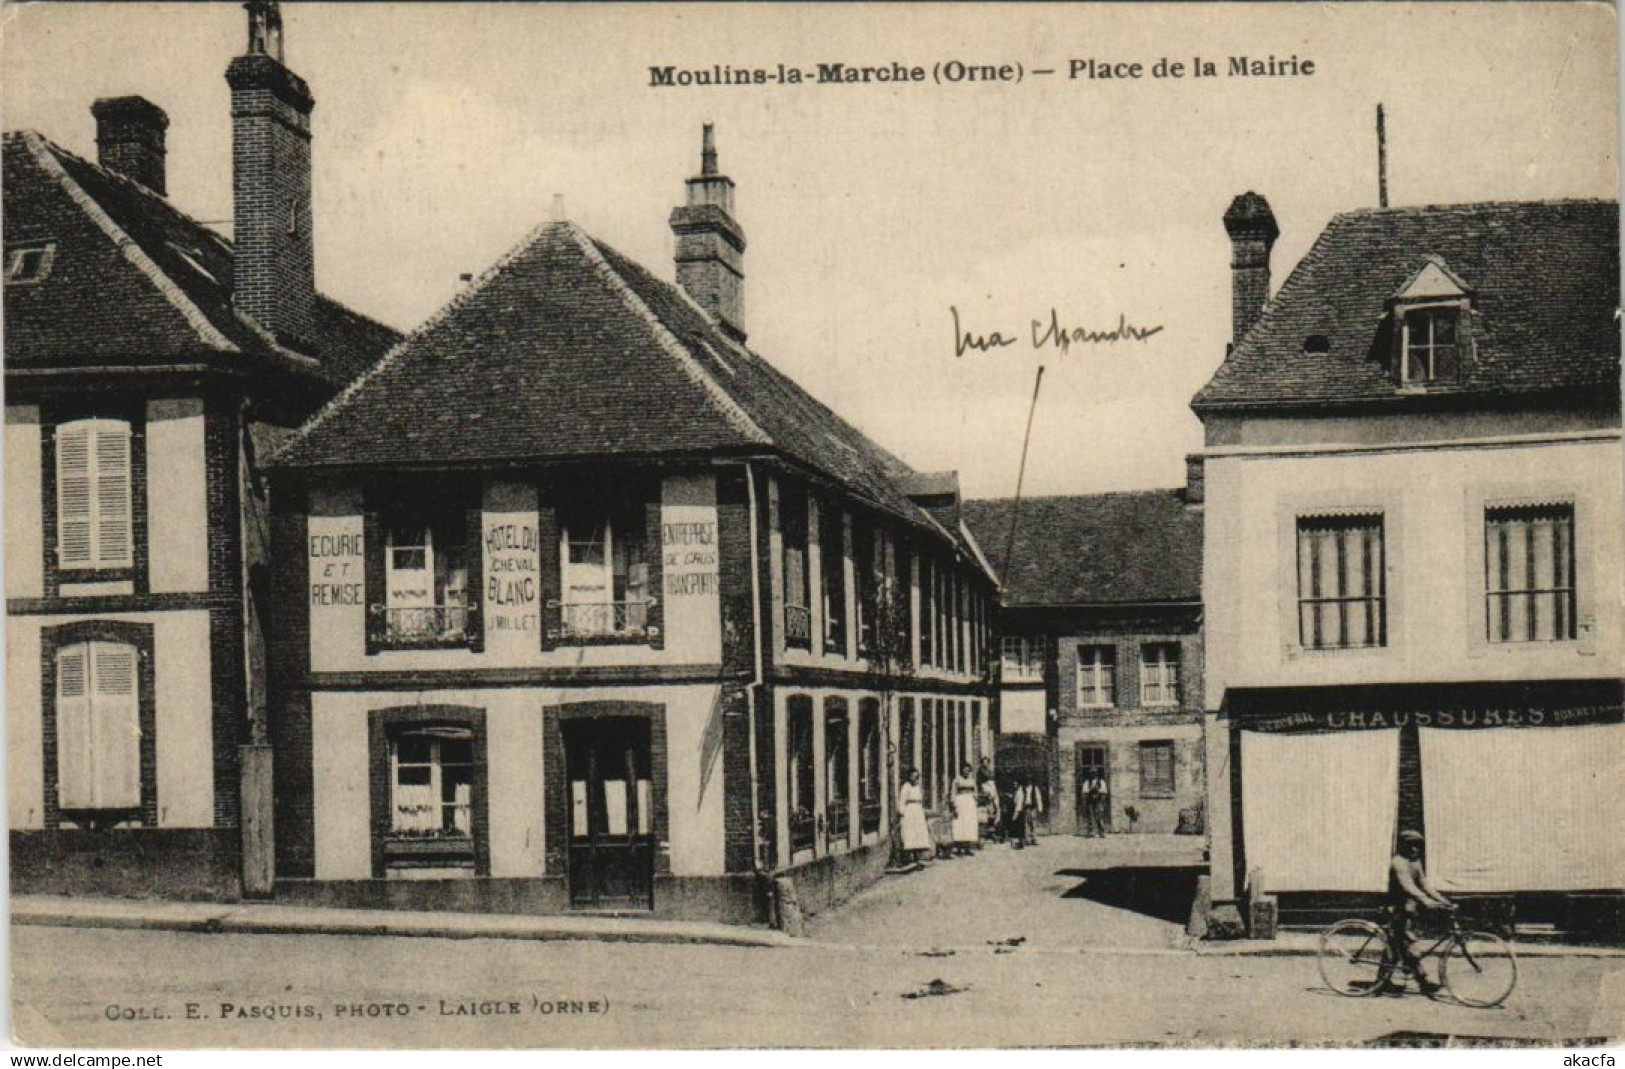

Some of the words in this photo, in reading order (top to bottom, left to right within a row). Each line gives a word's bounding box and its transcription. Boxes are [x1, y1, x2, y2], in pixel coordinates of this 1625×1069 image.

[310, 533, 364, 558] ECURIE
[323, 562, 351, 577] ET
[311, 583, 364, 607] REMISE
[487, 575, 536, 606] BLANC
[1327, 707, 1545, 727] CHAUSSURES
